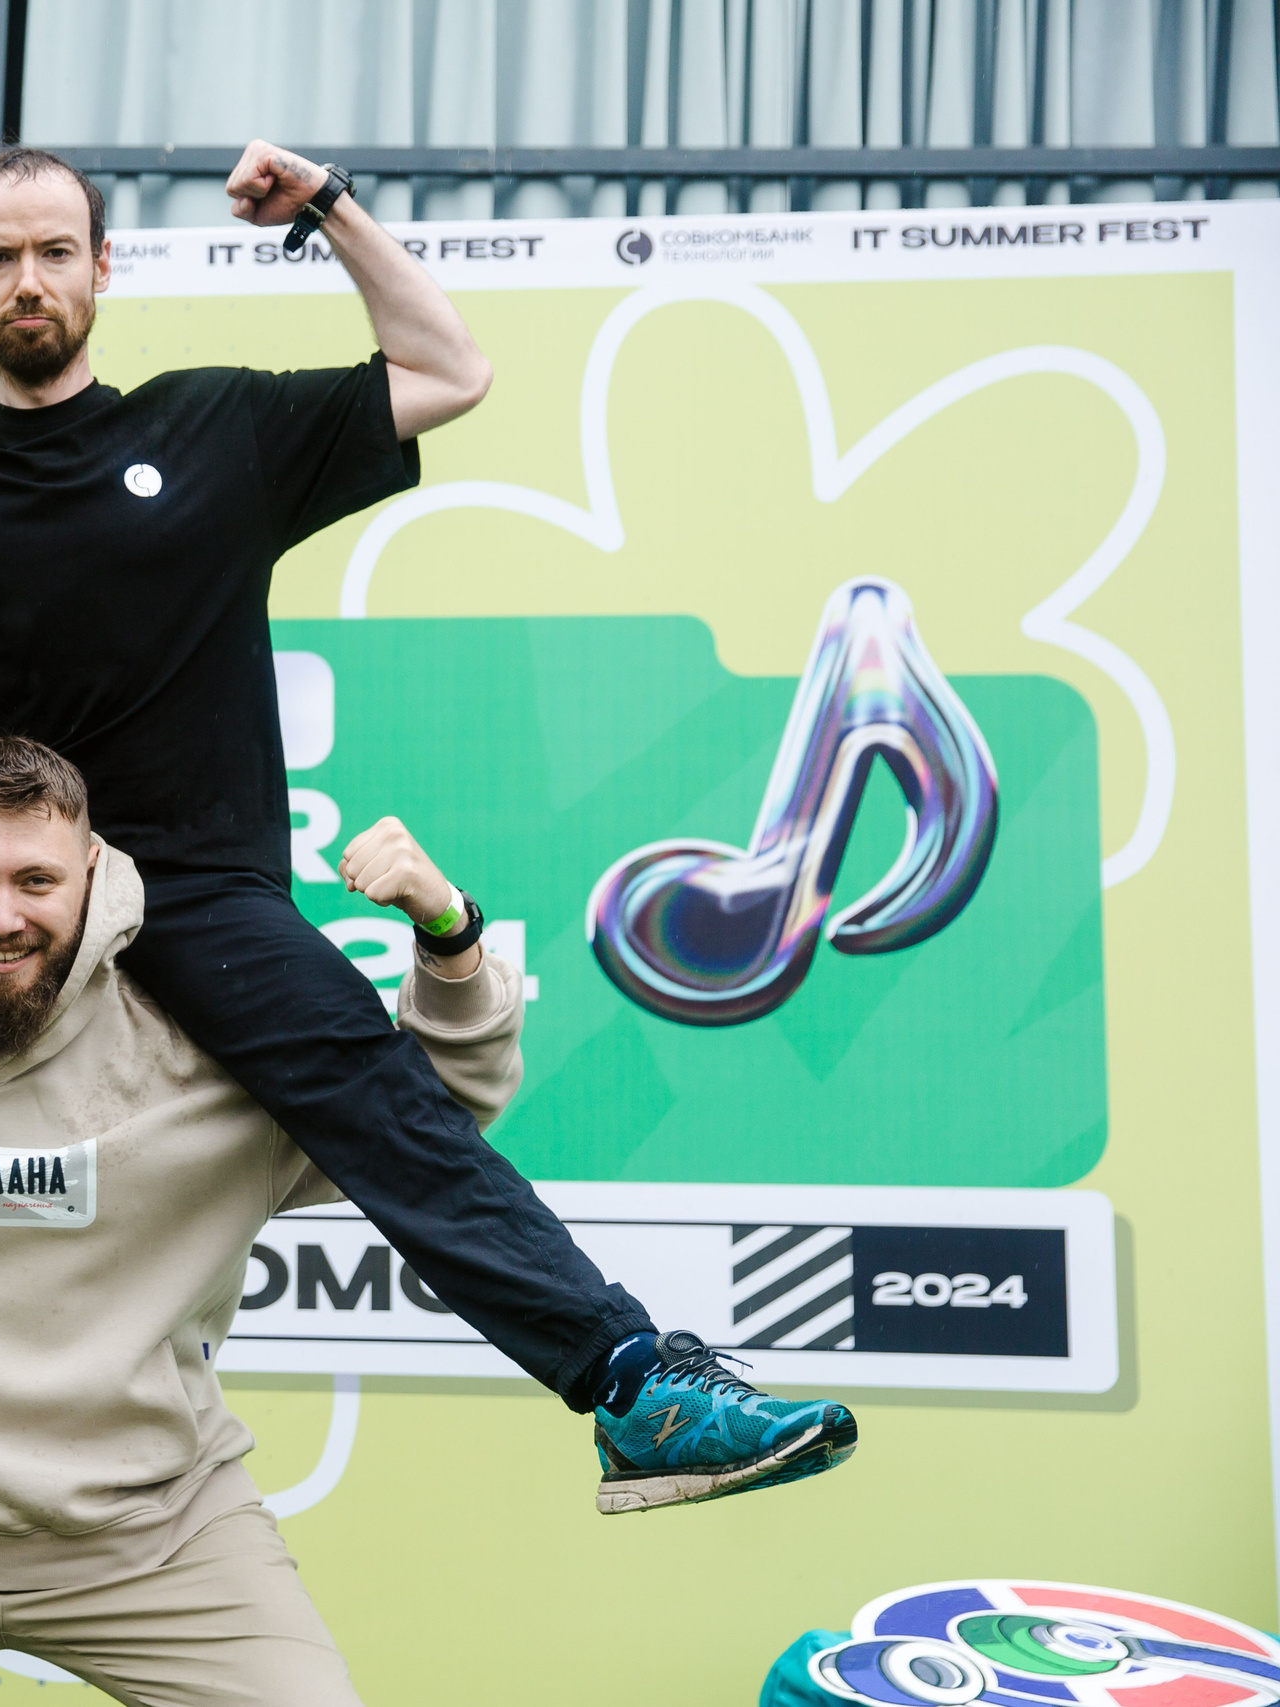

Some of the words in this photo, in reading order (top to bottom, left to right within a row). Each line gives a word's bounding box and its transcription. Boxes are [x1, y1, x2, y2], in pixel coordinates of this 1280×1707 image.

[661, 227, 814, 246] СОВКОМБАНК
[852, 226, 891, 250] IT
[900, 222, 1085, 249] SUMMER
[1097, 217, 1211, 242] FEST
[208, 244, 242, 264] IT
[439, 237, 544, 259] FEST
[872, 1271, 1028, 1309] 2024
